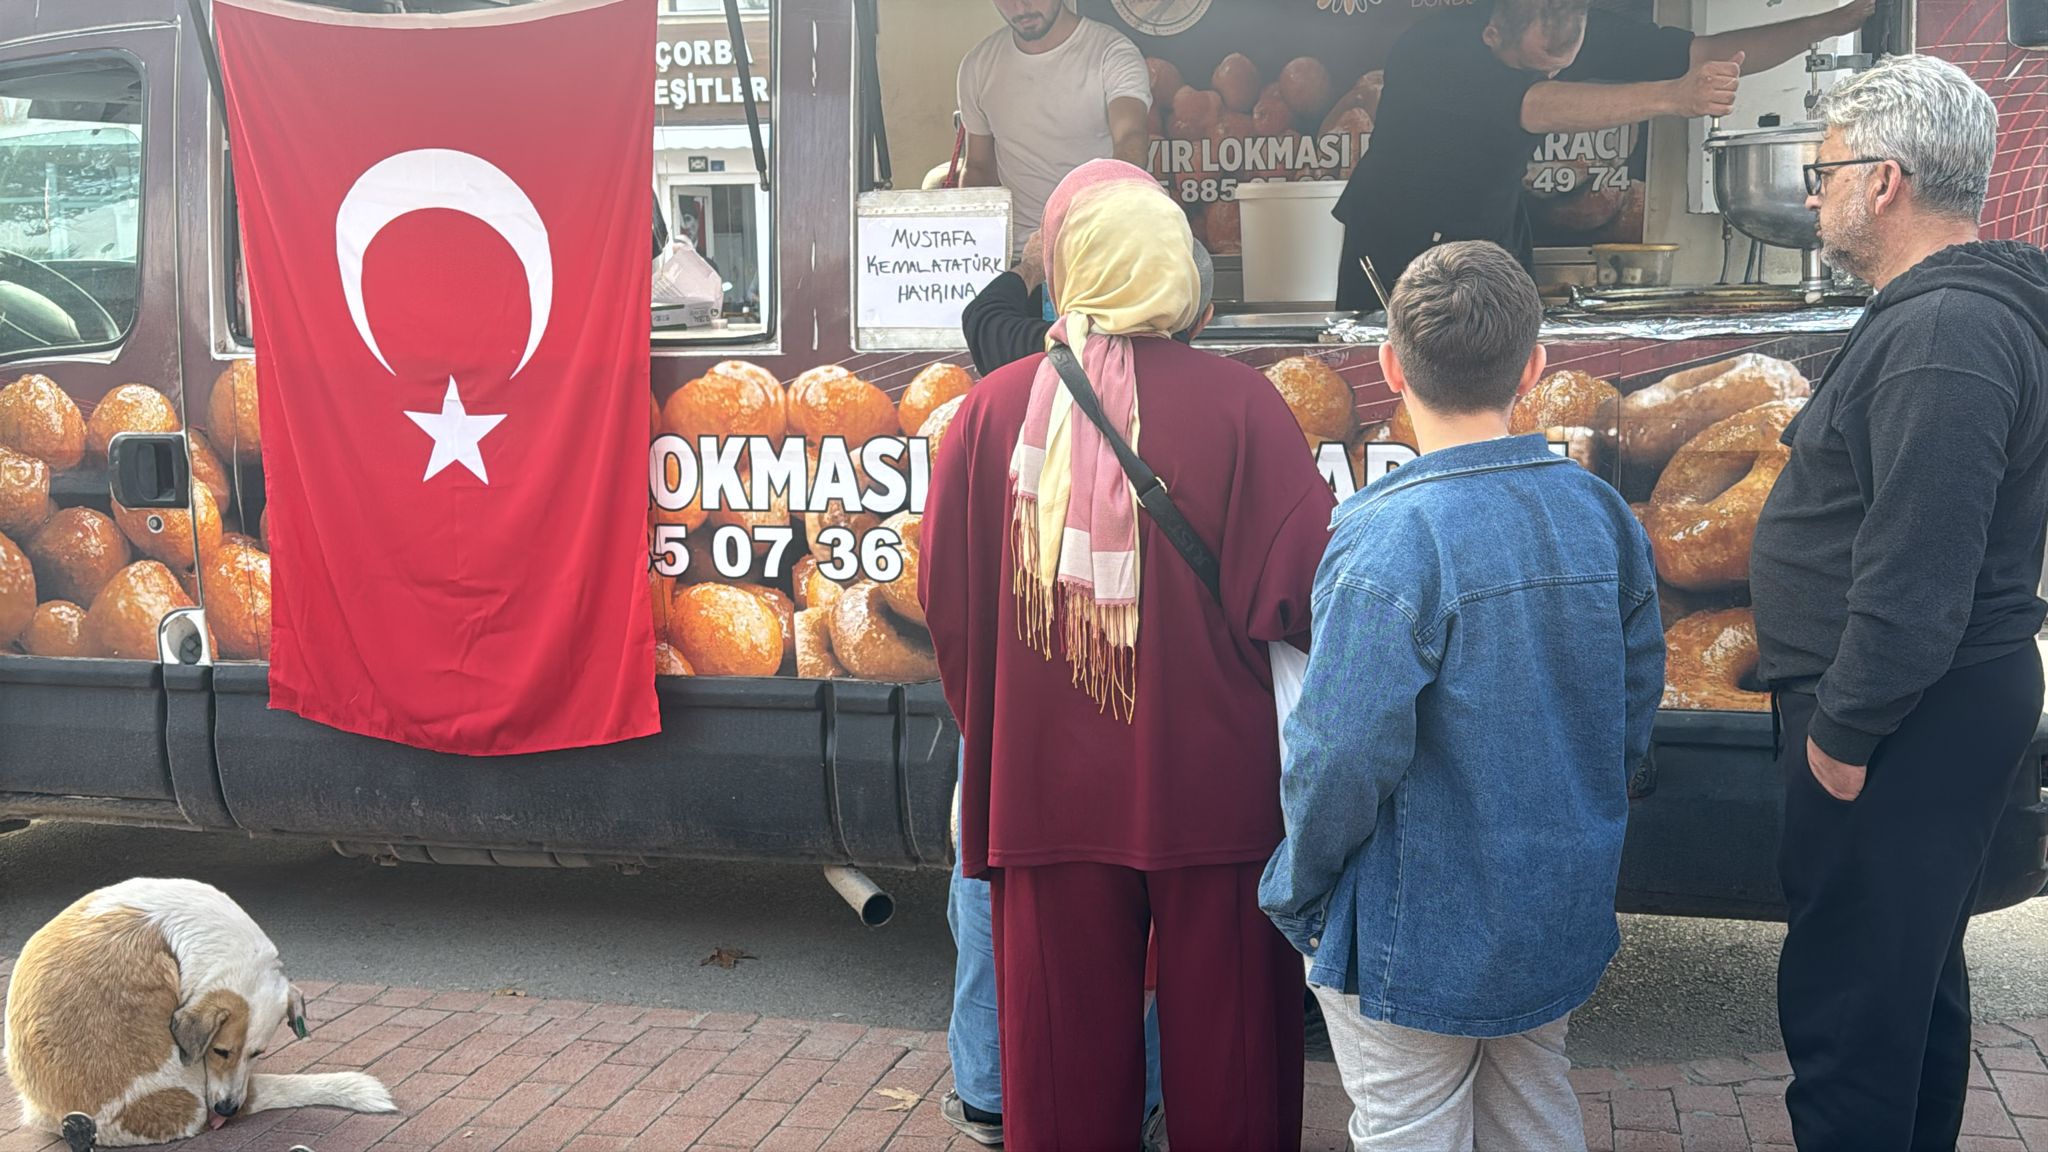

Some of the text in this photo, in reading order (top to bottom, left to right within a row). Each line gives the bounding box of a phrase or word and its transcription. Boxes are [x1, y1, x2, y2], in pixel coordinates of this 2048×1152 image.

[1202, 134, 1350, 172] LOKMASI
[1181, 178, 1237, 203] 885
[1533, 168, 1577, 192] 49
[1588, 166, 1630, 191] 74
[891, 228, 977, 249] MUSTAFA
[898, 282, 977, 303] HAYRINA
[648, 433, 931, 513] OKMASI
[712, 524, 793, 579] 07
[816, 527, 904, 582] 36
